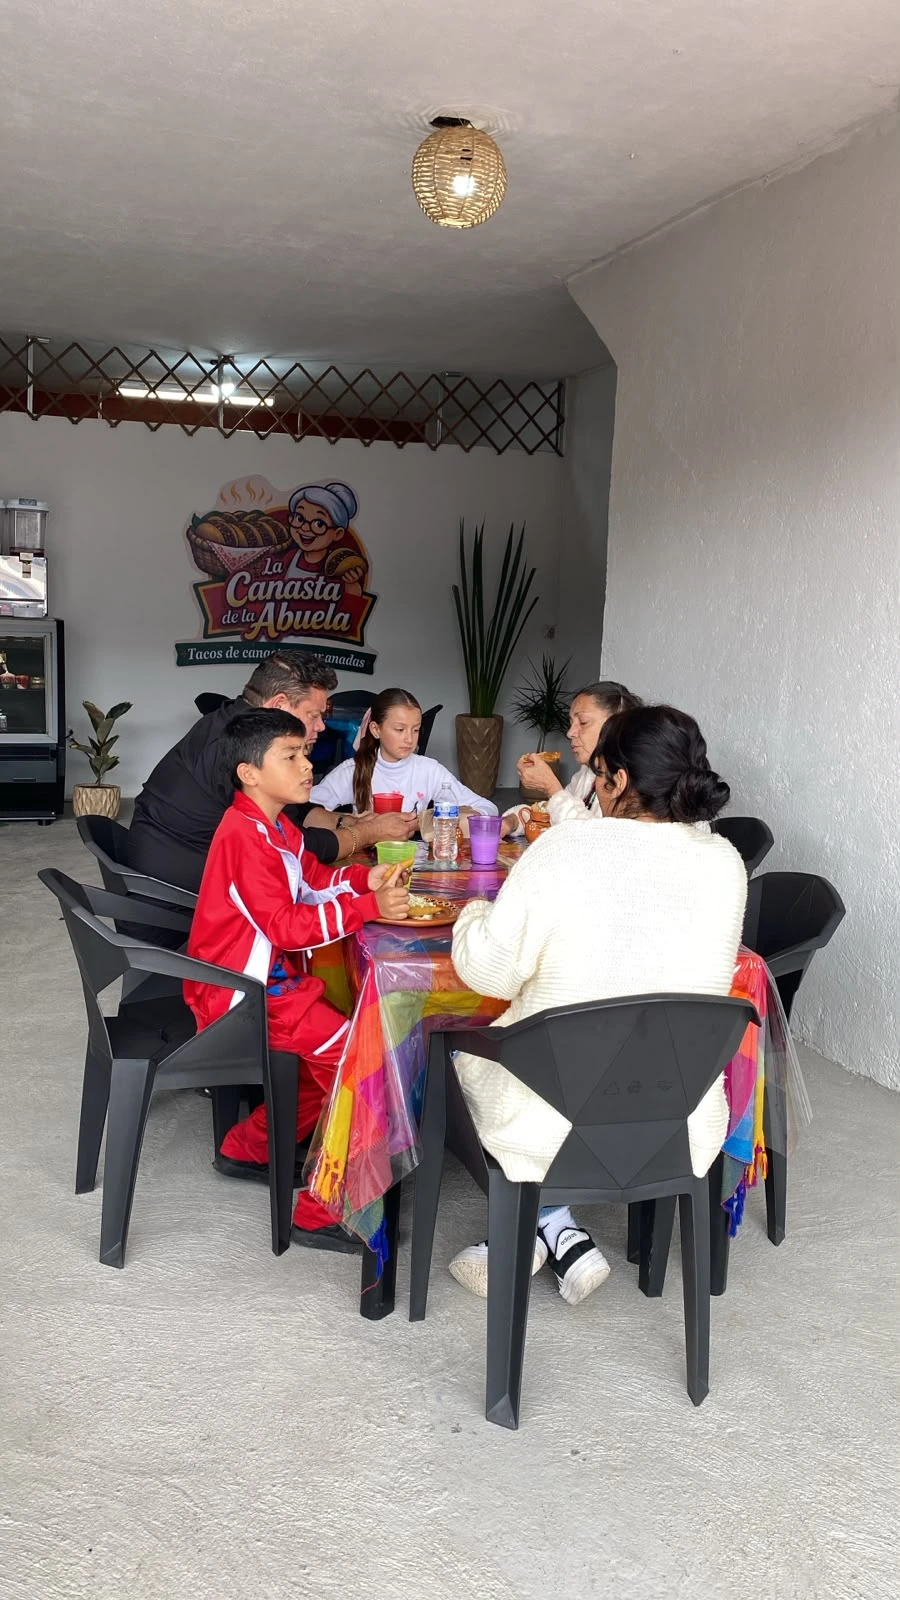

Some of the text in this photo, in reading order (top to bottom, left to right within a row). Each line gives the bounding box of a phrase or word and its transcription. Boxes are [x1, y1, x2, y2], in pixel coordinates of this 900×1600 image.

[262, 557, 283, 576] La
[226, 571, 342, 608] Canasta
[222, 601, 351, 640] de la Abuela
[187, 645, 366, 668] Tacos de cana anadas
[560, 1232, 577, 1246] adidas
